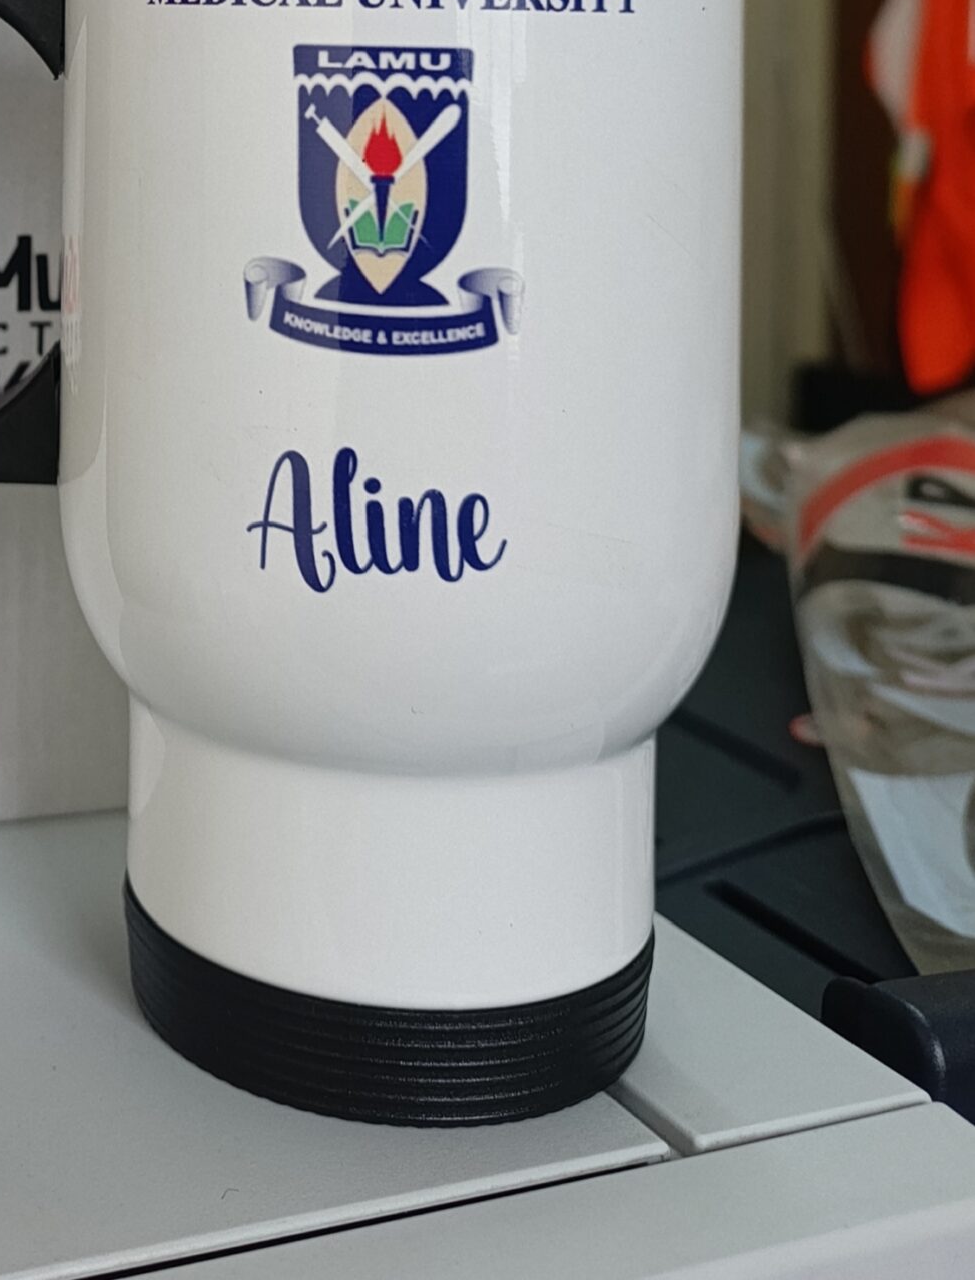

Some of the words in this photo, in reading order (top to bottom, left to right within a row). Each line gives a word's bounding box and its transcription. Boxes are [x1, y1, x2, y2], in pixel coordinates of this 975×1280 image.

[317, 50, 453, 71] LAMU
[283, 311, 373, 344] KNOWLEDGE
[376, 330, 388, 345] &
[391, 322, 486, 346] EXCELLENCE
[245, 447, 508, 593] Aline
